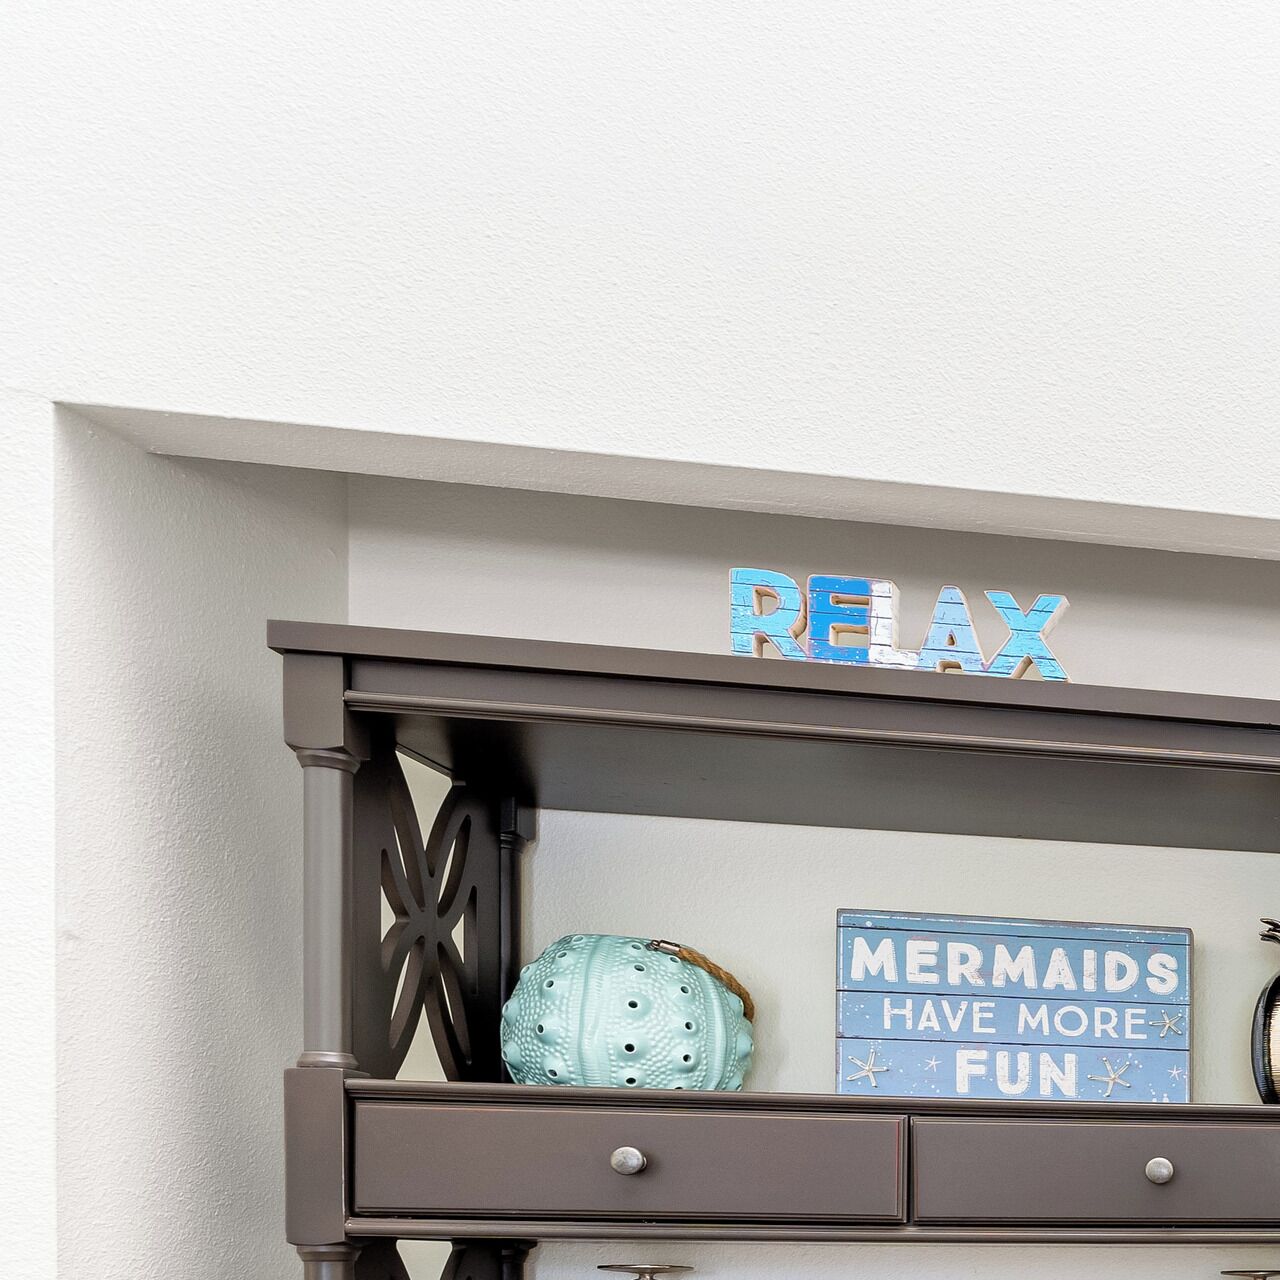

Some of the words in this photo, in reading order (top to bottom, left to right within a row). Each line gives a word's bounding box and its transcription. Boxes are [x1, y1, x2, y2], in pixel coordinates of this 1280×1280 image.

[729, 567, 1071, 682] RELAX
[850, 937, 1179, 995] MERMAIDS
[883, 998, 996, 1034] HAVE
[1018, 1003, 1148, 1040] MORE
[955, 1050, 1080, 1097] FUN
